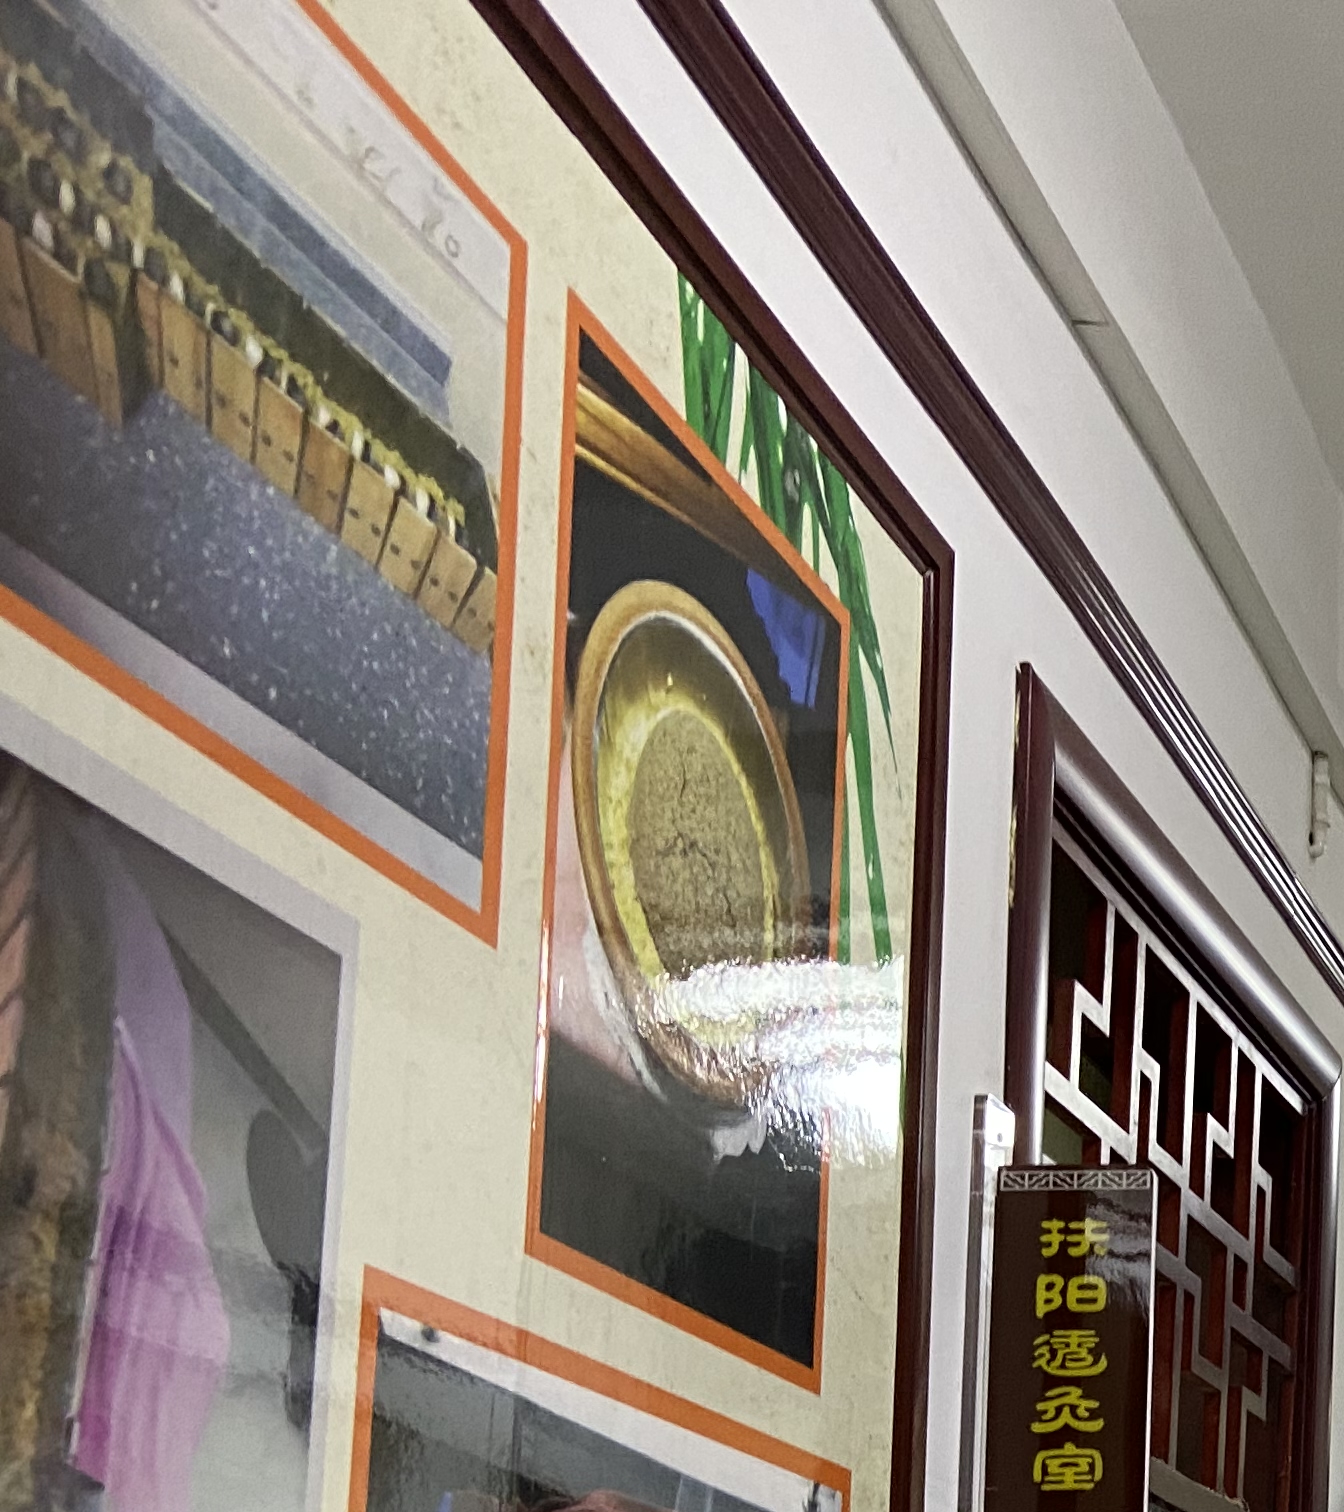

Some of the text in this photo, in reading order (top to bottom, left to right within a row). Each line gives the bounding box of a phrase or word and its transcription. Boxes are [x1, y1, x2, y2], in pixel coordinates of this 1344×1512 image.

[1030, 1218, 1108, 1491] 扶阳透灸室
